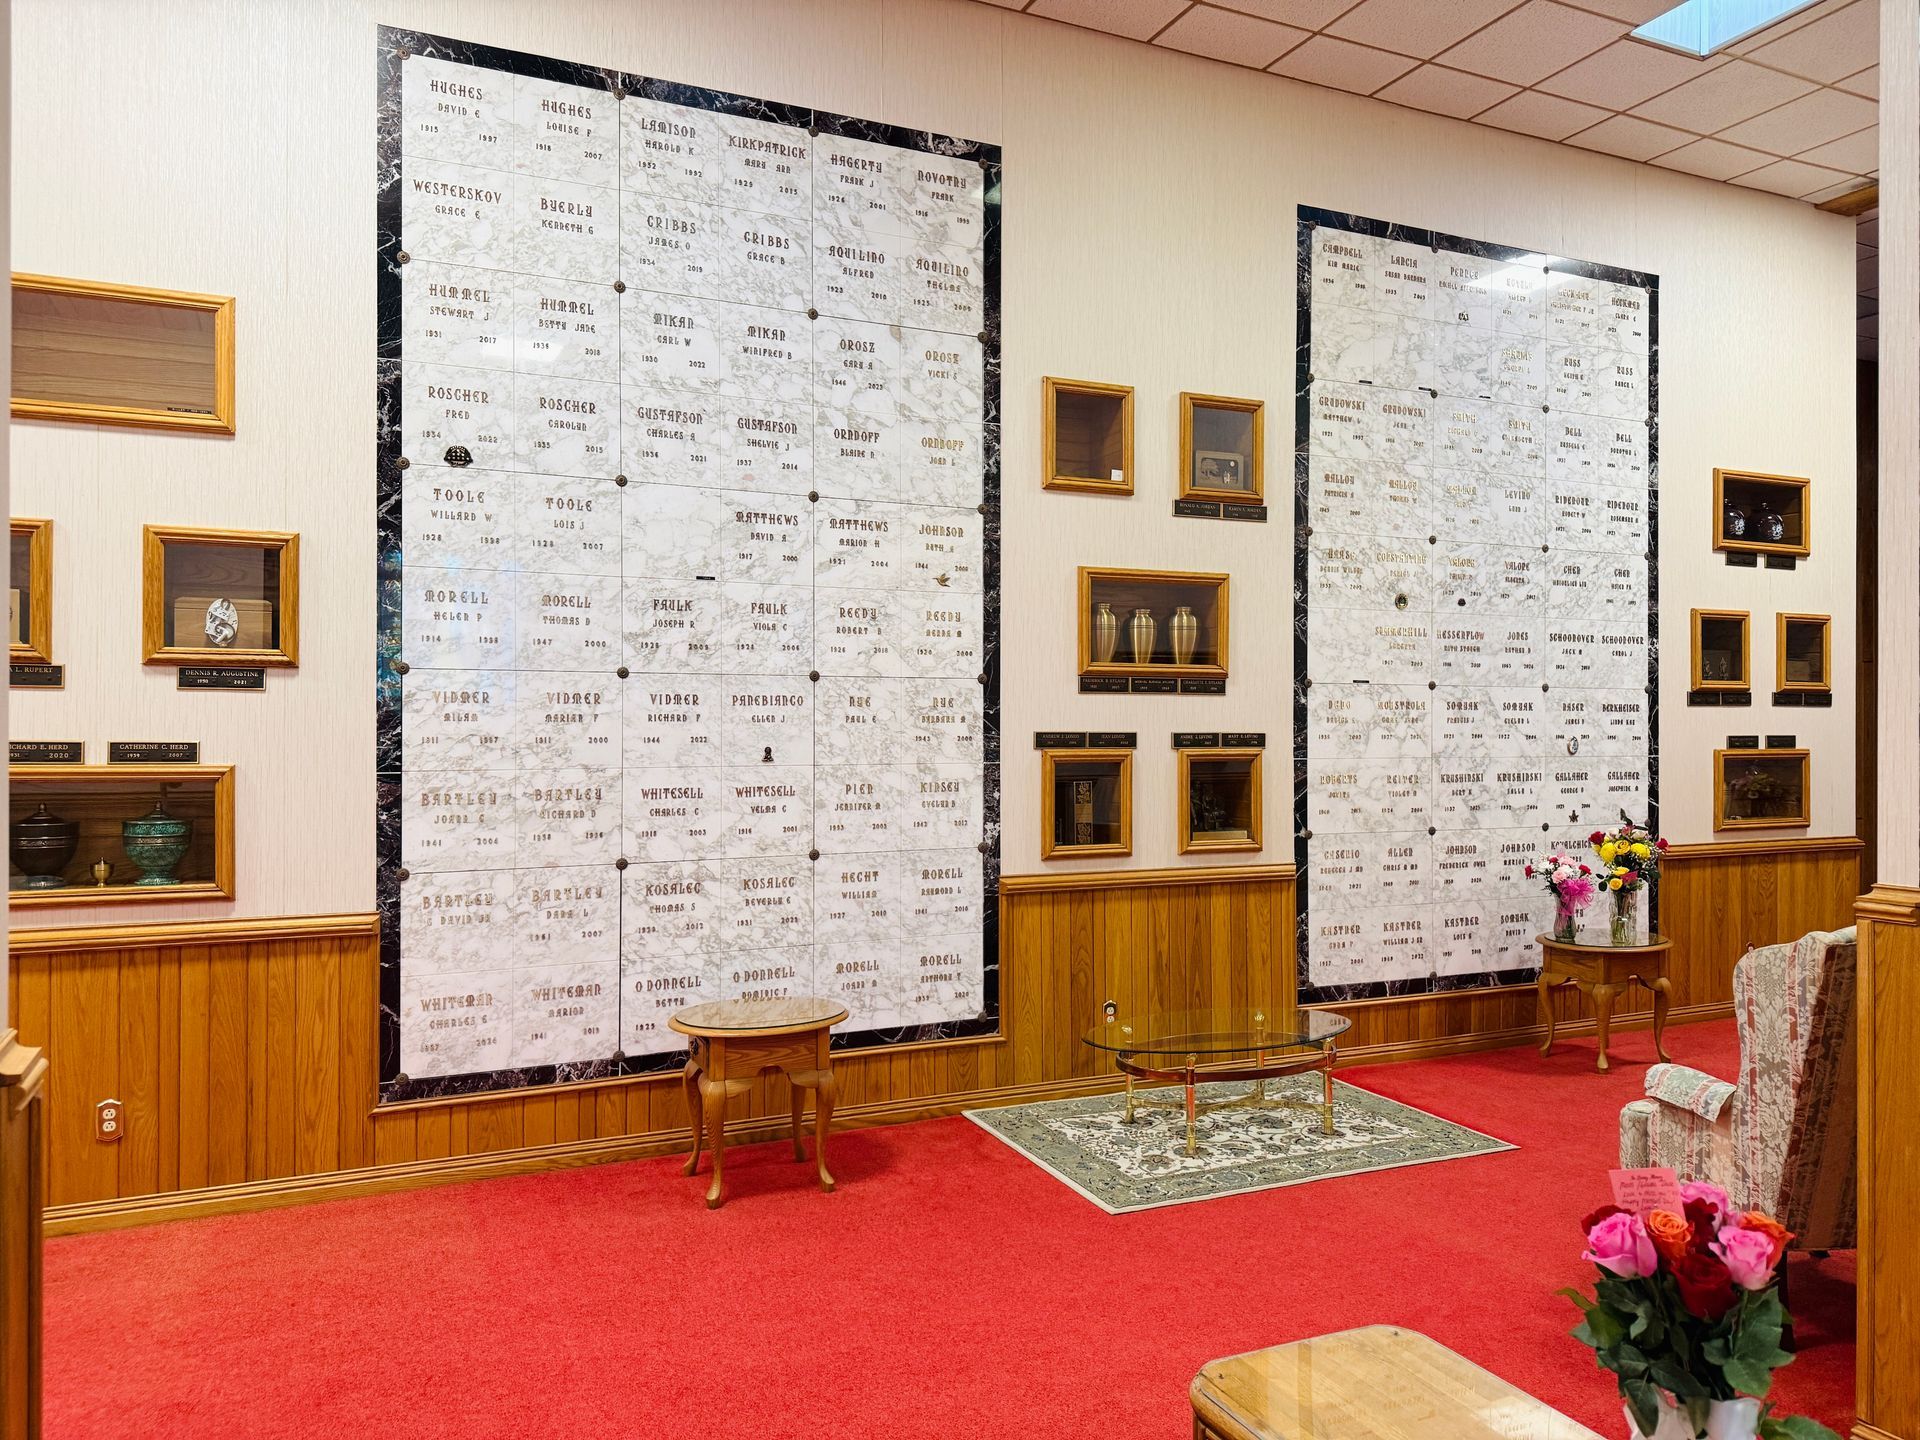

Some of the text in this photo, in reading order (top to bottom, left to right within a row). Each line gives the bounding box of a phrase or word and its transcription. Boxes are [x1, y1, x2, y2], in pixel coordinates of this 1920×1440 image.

[430, 80, 483, 101] HUGHES
[541, 99, 592, 120] HUGHES
[641, 117, 696, 139] LAMISON
[728, 135, 806, 160] KIRKPATRICK
[830, 154, 882, 174] HAGERTY
[918, 170, 967, 189] NOVOTNY
[413, 179, 502, 204] WESTERSKOV
[540, 197, 592, 218] BYERLY
[647, 215, 697, 235] CRIBBS
[744, 231, 790, 250] CRIBBS
[829, 245, 885, 265] AQUILINO
[916, 258, 969, 280] AQUILINO
[429, 283, 491, 303] HUMMEL
[540, 298, 594, 316] HUMMEL
[653, 313, 694, 330] MIKAN
[747, 326, 786, 342] MIKAN
[840, 339, 875, 354] OROSZ
[428, 386, 489, 404] ROSCHER
[540, 397, 596, 415] ROSCHER
[637, 406, 703, 425] GUSTAFSON
[737, 417, 797, 435] GUSTAFSON
[834, 428, 880, 444] ORNDOFF
[433, 488, 485, 504] TOOLE
[546, 497, 592, 512] TOOLE
[736, 511, 799, 527] MATTHEWS
[830, 518, 889, 533] MATTHEWS
[919, 523, 964, 538] JOHNSON
[424, 590, 489, 605] MORELL
[543, 595, 592, 609] MORELL
[653, 599, 694, 612] FAULK
[751, 602, 788, 616] FAULK
[840, 607, 880, 622] REEDY
[546, 692, 601, 705] VIDMER
[650, 694, 700, 706] VIDMER
[732, 695, 804, 707] PANEBIANCO
[641, 787, 704, 800] WHITESELL
[735, 785, 796, 798] WHITESELL
[845, 783, 874, 795] PIEN
[920, 781, 960, 793] KINSEY
[841, 871, 879, 884] HECHT
[922, 867, 963, 880] MORELL
[645, 878, 703, 896] KOSALEC
[743, 877, 796, 892] KOSALEC
[836, 960, 880, 975] MORELL
